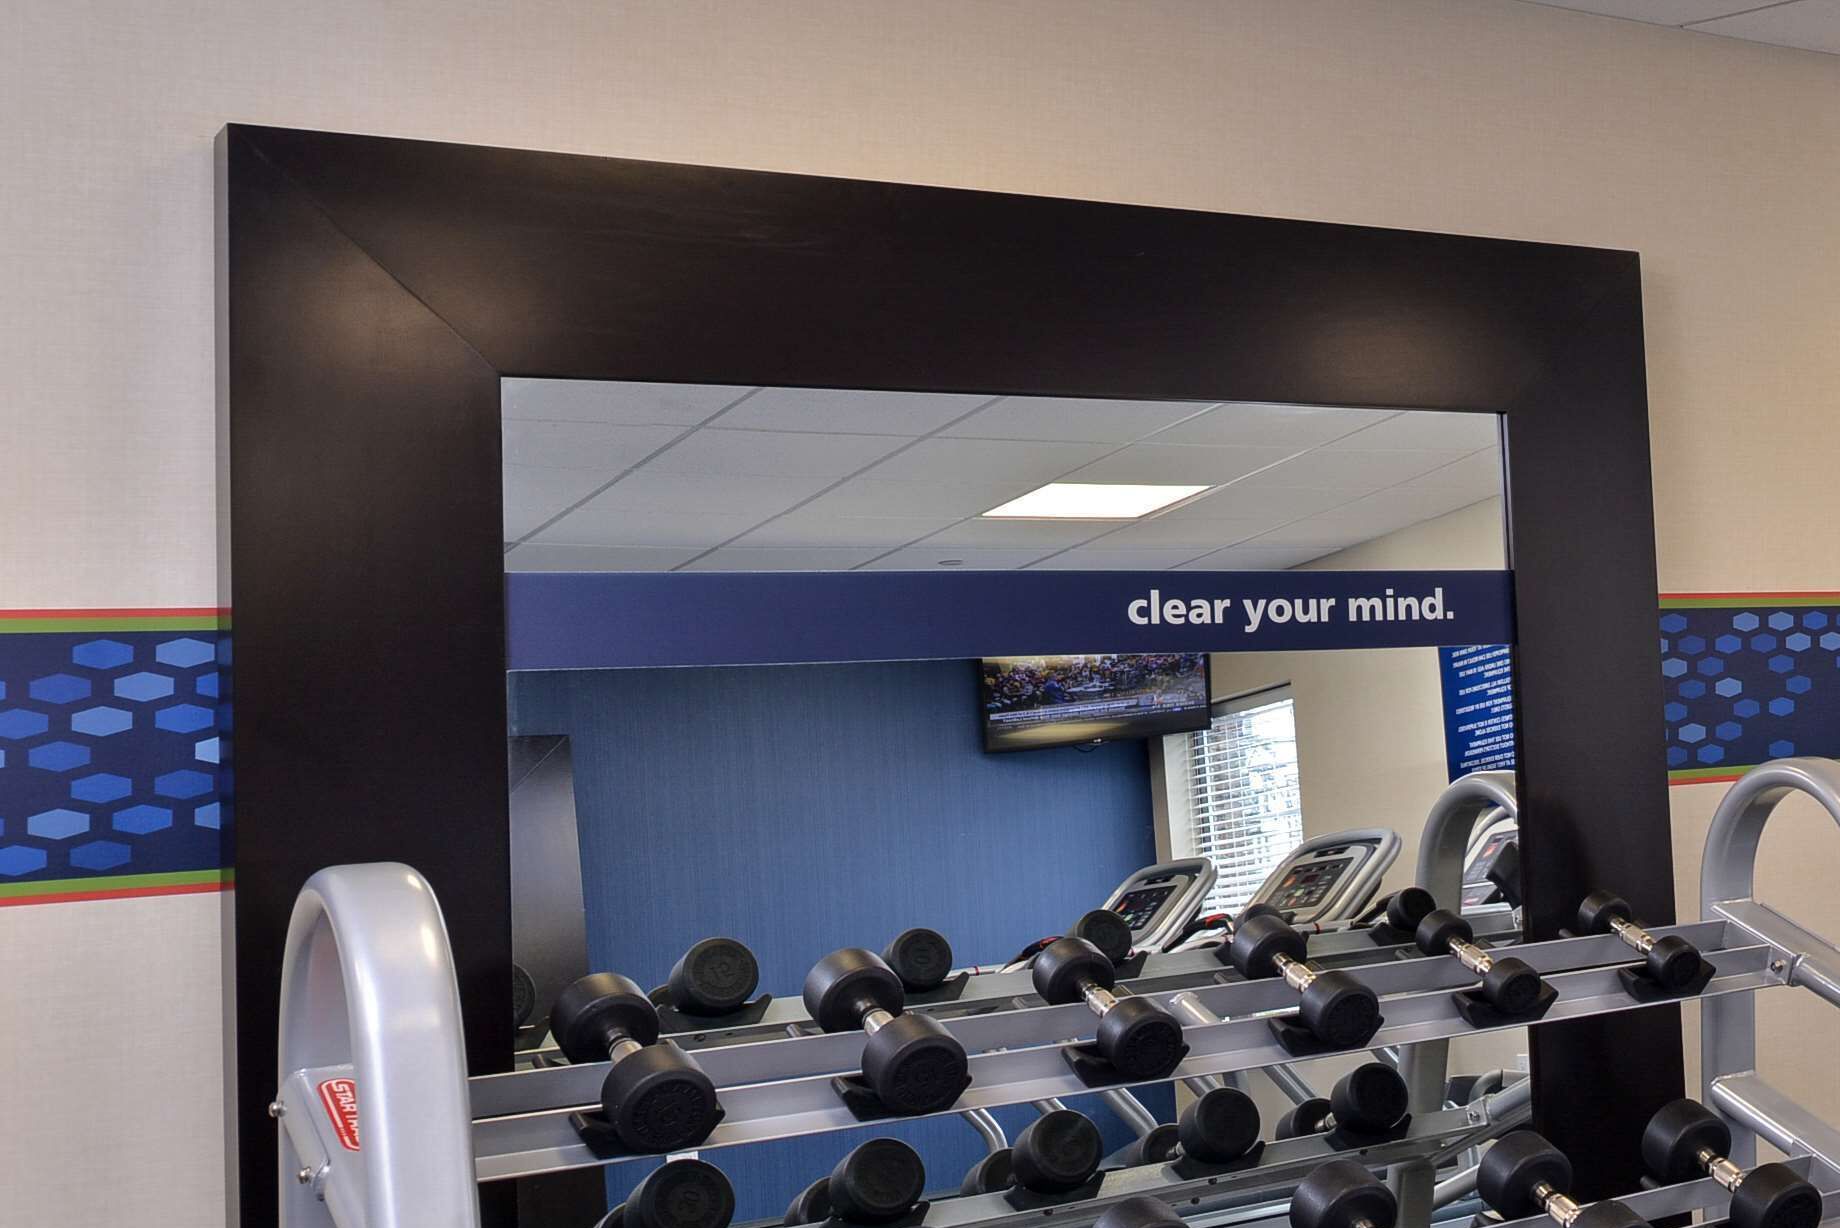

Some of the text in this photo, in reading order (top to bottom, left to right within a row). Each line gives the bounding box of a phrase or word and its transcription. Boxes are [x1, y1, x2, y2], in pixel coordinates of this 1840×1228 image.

[1128, 587, 1454, 632] clear your mind.
[332, 1081, 357, 1112] STAR
